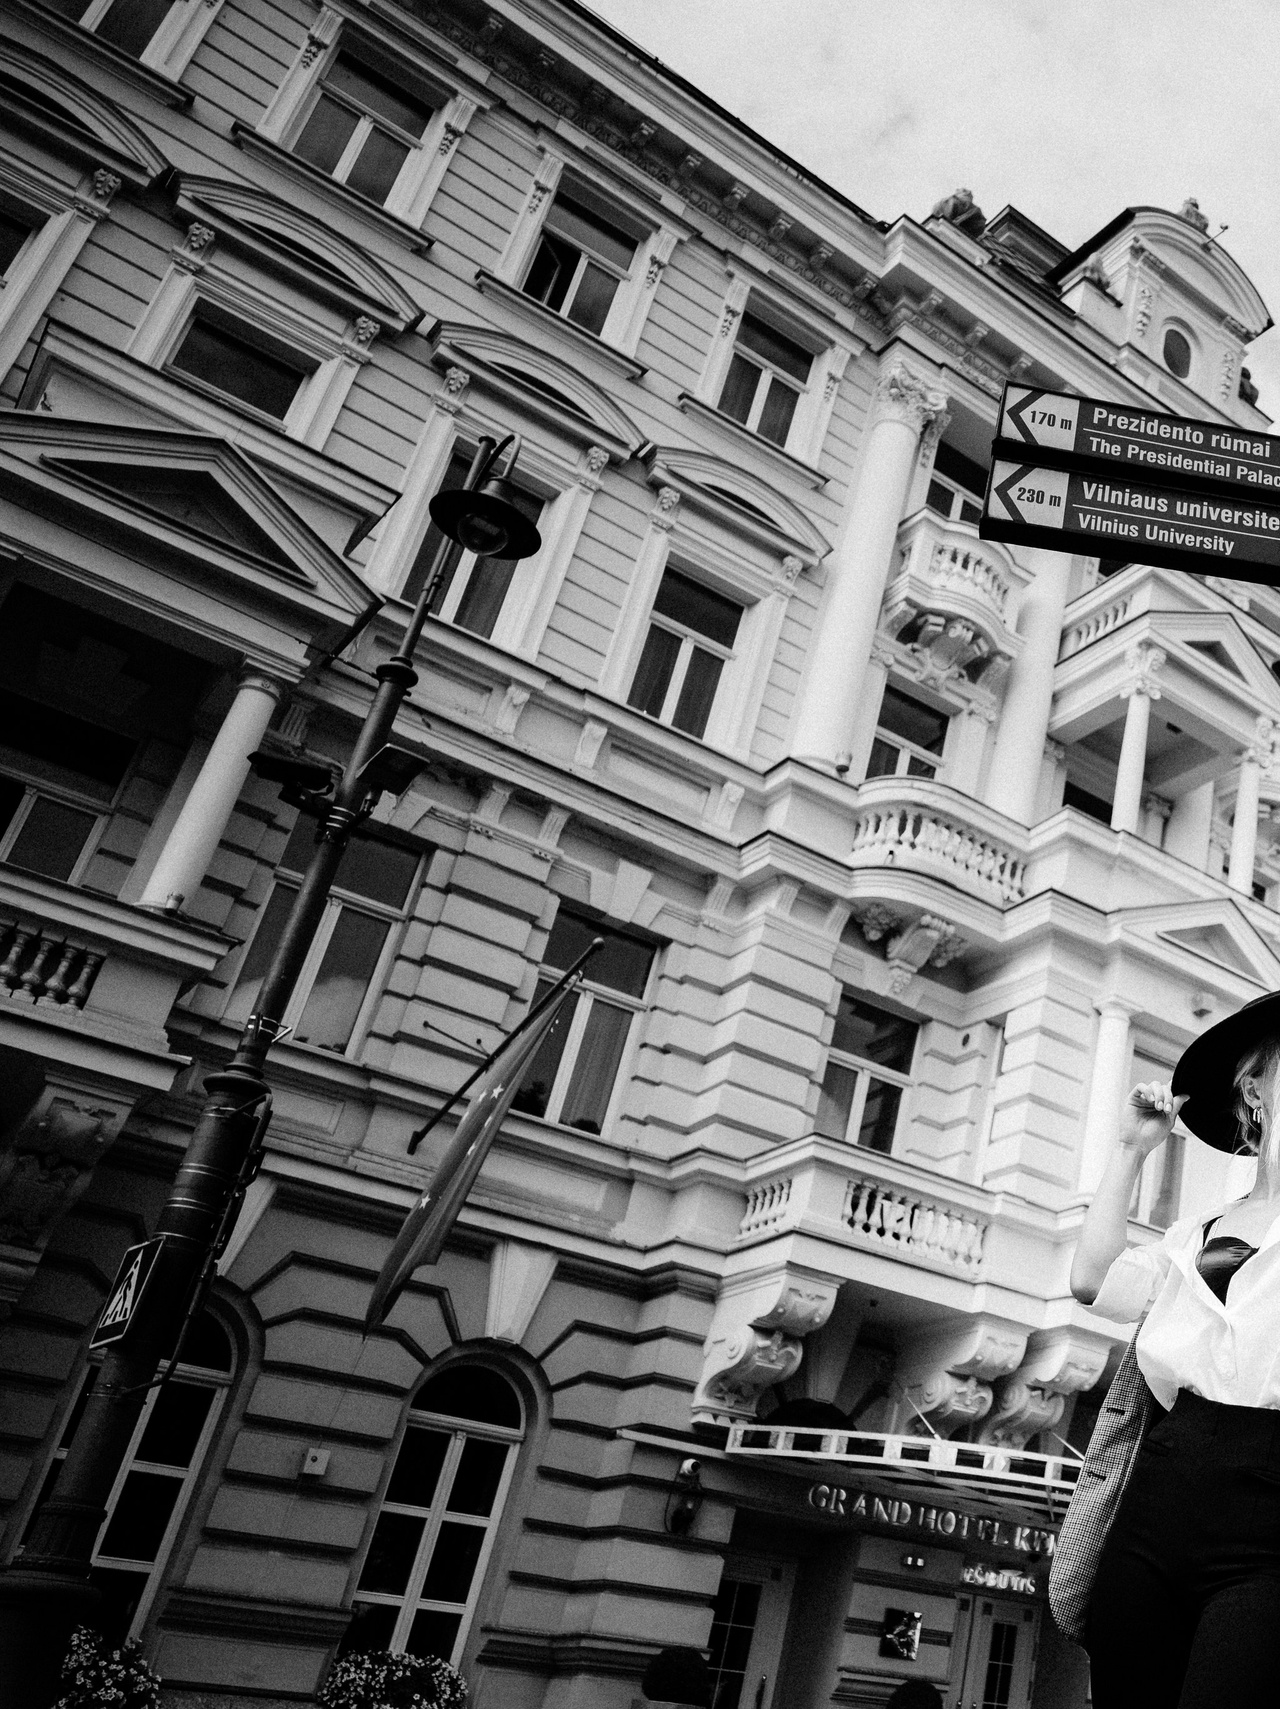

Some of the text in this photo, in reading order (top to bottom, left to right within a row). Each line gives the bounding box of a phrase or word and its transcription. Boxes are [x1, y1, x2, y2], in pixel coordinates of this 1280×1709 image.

[1029, 409, 1073, 431] 170 m
[1092, 407, 1271, 459] Prezidento rūmai
[1089, 436, 1121, 457] The
[1127, 444, 1231, 479] Presidential
[1016, 485, 1062, 508] 230 m
[1082, 481, 1168, 514] Vilniaus
[1077, 512, 1236, 557] Vilnius University
[808, 1484, 912, 1526] GRAND
[919, 1506, 1009, 1546] HOTEL
